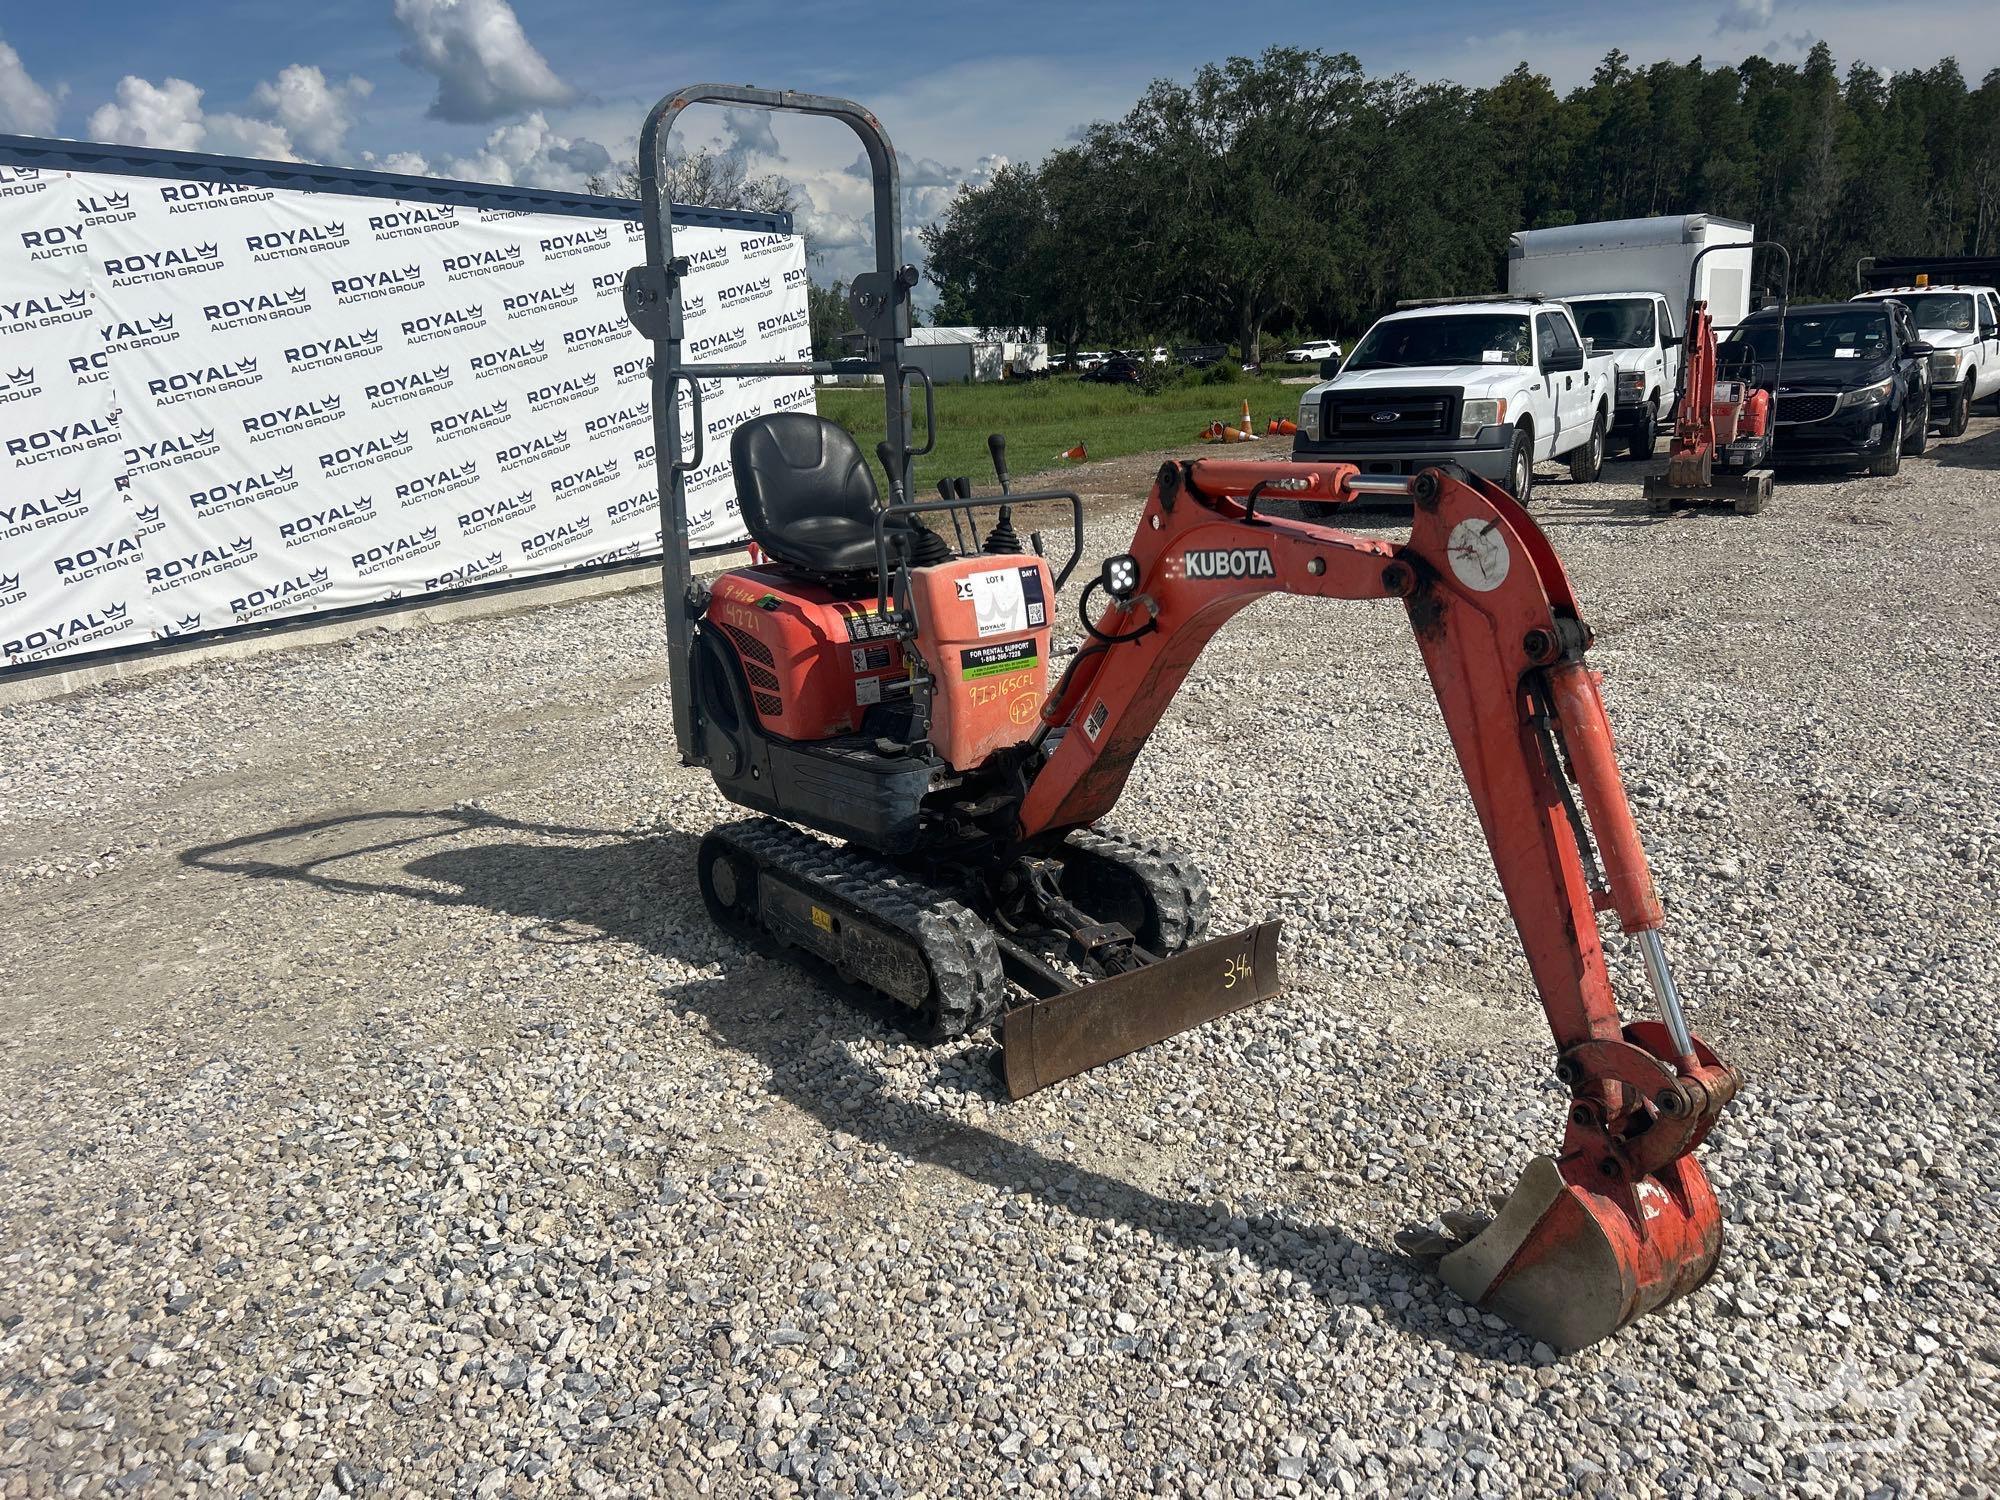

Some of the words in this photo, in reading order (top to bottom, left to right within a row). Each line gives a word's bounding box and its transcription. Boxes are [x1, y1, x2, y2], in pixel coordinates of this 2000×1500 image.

[169, 198, 228, 214] AUCTION
[230, 192, 274, 205] GROUP
[85, 212, 136, 226] GROUP
[368, 209, 439, 230] ROYAL
[376, 227, 422, 241] AUCTION
[423, 220, 459, 232] GROUP
[21, 224, 83, 248] ROY
[246, 227, 327, 251] ROYAL
[540, 231, 595, 252] ROYAL
[740, 234, 782, 252] ROYAL
[31, 244, 88, 261] AUCTIO
[104, 248, 198, 277] ROYAL
[254, 246, 308, 262] AUCTION
[309, 239, 350, 252] GROUP
[442, 249, 506, 273] ROYAL
[545, 248, 582, 261] AUCTION
[583, 241, 611, 253] GROUP
[744, 249, 772, 260] AUCTION
[772, 243, 794, 252] GROUP
[112, 269, 176, 288] AUCTION
[177, 261, 224, 276] GROUP
[448, 267, 491, 282] AUCTION
[492, 260, 524, 272] GROUP
[706, 259, 729, 270] GROUP
[783, 270, 806, 283] ROY
[331, 270, 404, 296] ROYAL
[338, 289, 387, 305] AUCTION
[388, 281, 425, 294] GROUP
[592, 271, 624, 289] ROY
[718, 282, 760, 300] ROYAL
[203, 293, 284, 321] ROYAL
[503, 288, 562, 311] ROYAL
[508, 305, 547, 320] AUCTION
[548, 297, 578, 310] GROUP
[721, 297, 750, 309] AUCTION
[750, 290, 773, 300] GROUP
[39, 309, 93, 327] GROUP
[211, 313, 267, 332] AUCTION
[269, 304, 312, 320] GROUP
[401, 310, 468, 336] ROYAL
[757, 312, 798, 333] ROYAL
[761, 327, 787, 339] AUCTION
[788, 320, 807, 330] GROUP
[130, 332, 180, 348] GROUP
[407, 328, 451, 345] AUCTION
[453, 320, 486, 334] GROUP
[563, 321, 617, 344] ROYAL
[568, 338, 604, 353] AUCTION
[604, 330, 632, 343] GROUP
[690, 332, 734, 354] ROYAL
[284, 335, 361, 364] ROYAL
[291, 355, 342, 374] AUCTION
[344, 345, 383, 360] GROUP
[470, 345, 531, 371] ROYAL
[694, 348, 723, 361] AUCTION
[724, 339, 747, 351] GROUP
[148, 364, 238, 396] ROYAL
[476, 363, 516, 380] AUCTION
[517, 354, 548, 368] GROUP
[613, 356, 654, 378] ROYA
[157, 386, 216, 407] AUCTION
[218, 374, 263, 395] GROUP
[364, 372, 434, 400] ROYAL
[371, 393, 418, 410] AUCTION
[419, 380, 454, 396] GROUP
[527, 379, 583, 404] ROYAL
[532, 398, 569, 413] AUCTION
[570, 386, 599, 400] GROUP
[242, 402, 323, 433] ROYAL
[250, 422, 303, 444] AUCTION
[305, 411, 346, 428] GROUP
[430, 406, 494, 434] ROYAL
[436, 425, 478, 444] AUCTION
[479, 414, 511, 429] GROUP
[585, 408, 638, 433] ROYAL
[5, 419, 108, 457] ROYAL
[589, 425, 624, 441] AUCTION
[16, 441, 84, 468] AUCTION
[173, 446, 220, 464] GROUP
[318, 438, 392, 469] ROYAL
[326, 457, 374, 479] AUCTION
[376, 446, 413, 462] GROUP
[496, 436, 554, 464] ROYAL
[501, 456, 540, 472] AUCTION
[541, 443, 570, 458] GROUP
[189, 474, 275, 508] ROYAL
[395, 468, 462, 499] ROYAL
[401, 490, 446, 508] AUCTION
[447, 475, 480, 492] GROUP
[551, 466, 605, 493] ROYAL
[556, 485, 593, 502] AUCTION
[592, 472, 620, 487] GROUP
[197, 495, 255, 518] AUCTION
[256, 481, 299, 500] GROUP
[607, 491, 657, 517] ROYAL
[35, 506, 89, 528] GROUP
[279, 505, 355, 538] ROYAL
[457, 498, 519, 528] ROYAL
[463, 516, 504, 536] AUCTION
[505, 504, 536, 520] GROUP
[611, 508, 645, 525] AUCTION
[286, 528, 337, 548] AUCTION
[338, 511, 376, 530] GROUP
[521, 523, 577, 552] ROYAL
[691, 521, 714, 535] GROUP
[351, 535, 421, 567] ROYAL
[527, 544, 564, 560] AUCTION
[564, 528, 593, 544] GROUP
[145, 546, 233, 583] ROYAL
[359, 554, 404, 577] AUCTION
[405, 540, 441, 558] GROUP
[1185, 549, 1275, 577] KUBOTA
[64, 558, 128, 586] AUCTION
[152, 568, 211, 595] AUCTION
[213, 552, 258, 573] GROUP
[424, 560, 489, 590] ROYAL
[473, 565, 508, 581] GROUP
[985, 575, 999, 584] LOT
[1021, 569, 1033, 578] DAY
[1033, 568, 1037, 576] 1
[230, 577, 310, 613] ROYAL
[236, 602, 291, 623] AUCTION
[293, 582, 333, 602] GROUP
[82, 619, 134, 642] GROUP
[726, 603, 760, 632] 4221
[2, 614, 105, 656] ROYAL
[969, 650, 982, 659] FOR
[983, 647, 1004, 656] RENTAL
[1004, 641, 1029, 652] SUPPORT
